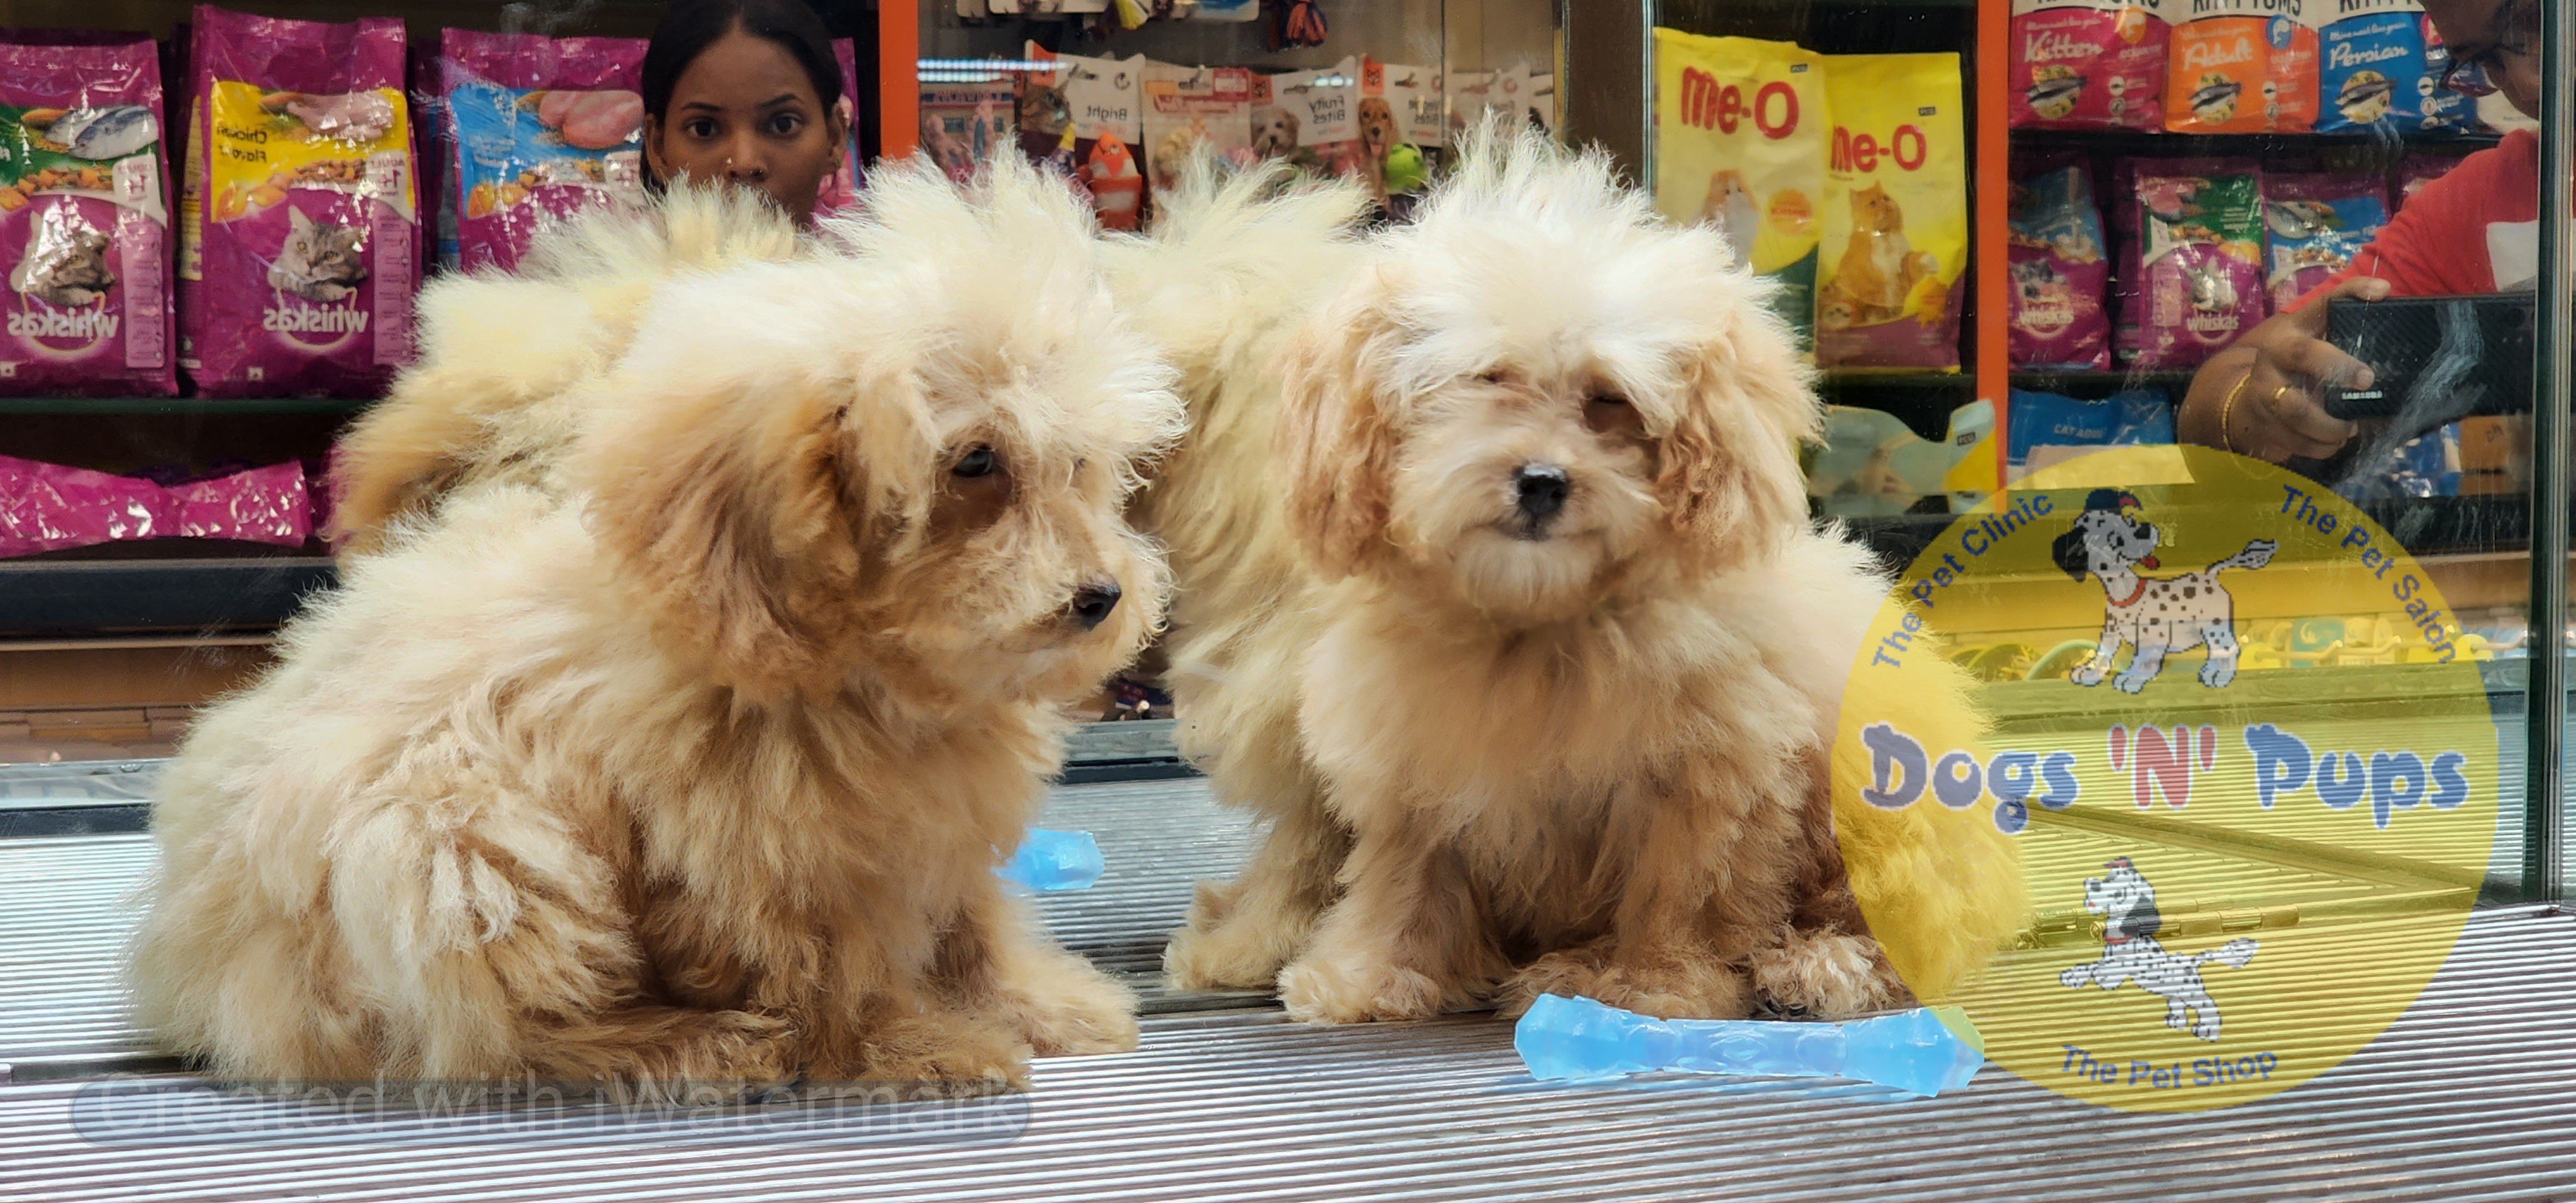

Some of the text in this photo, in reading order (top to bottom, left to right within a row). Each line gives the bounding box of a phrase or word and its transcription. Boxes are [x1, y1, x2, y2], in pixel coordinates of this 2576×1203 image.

[2024, 31, 2104, 62] Kitten
[2183, 37, 2253, 71] Adult
[2329, 42, 2409, 70] Persian
[2186, 312, 2240, 332] whiskas
[2053, 422, 2076, 435] CAT
